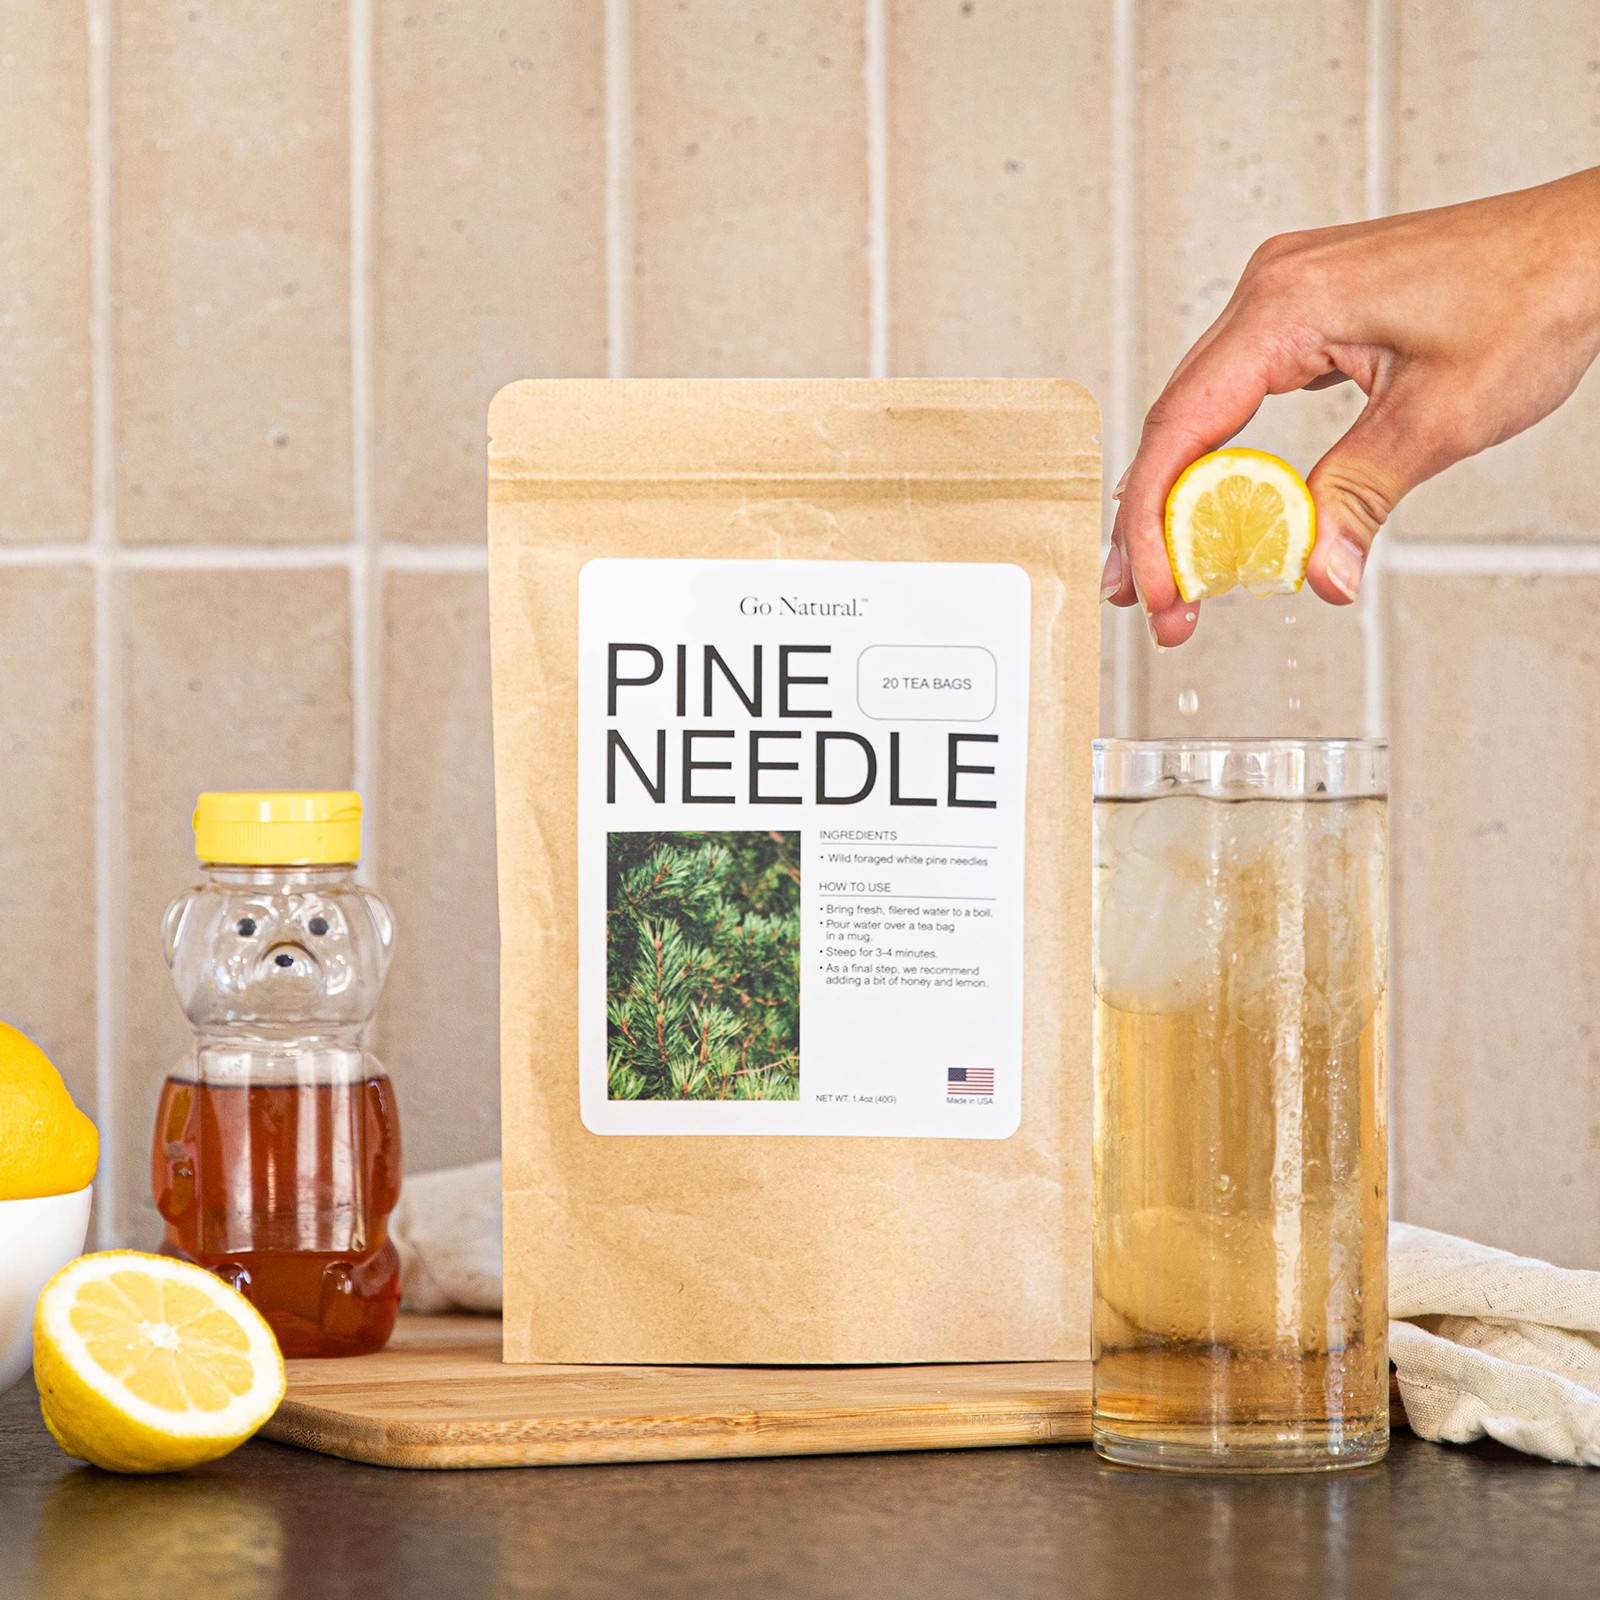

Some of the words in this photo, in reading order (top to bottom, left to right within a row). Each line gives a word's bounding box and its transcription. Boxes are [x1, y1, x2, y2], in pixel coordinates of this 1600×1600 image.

[739, 596, 772, 616] Go
[607, 643, 833, 718] PINE
[882, 677, 898, 690] 20
[902, 677, 929, 690] TEA
[933, 677, 972, 690] BAGS
[607, 729, 999, 809] NEEDLE
[820, 830, 897, 840] INGREDIENTS
[828, 854, 851, 863] Wild
[854, 854, 893, 865] foraged
[896, 855, 923, 864] white
[926, 856, 947, 866] pine
[950, 857, 988, 866] needles
[819, 882, 847, 891] HOW
[850, 882, 865, 892] TO
[868, 883, 891, 892] USE
[826, 904, 854, 916] Bring
[922, 907, 950, 916] water
[953, 908, 962, 917] to
[826, 919, 850, 929] Pour
[853, 921, 881, 929] water
[884, 922, 906, 930] over
[918, 922, 933, 931] tea
[936, 921, 955, 933] bag
[826, 931, 835, 940] in
[826, 947, 856, 959] Steep
[859, 947, 873, 957] for
[826, 963, 839, 973] As
[851, 964, 872, 973] final
[920, 965, 979, 976] recommend
[826, 976, 861, 987] adding
[873, 976, 886, 985] bit
[888, 976, 898, 986] of
[901, 977, 932, 988] honey
[934, 978, 953, 987] and
[977, 1097, 993, 1105] USA
